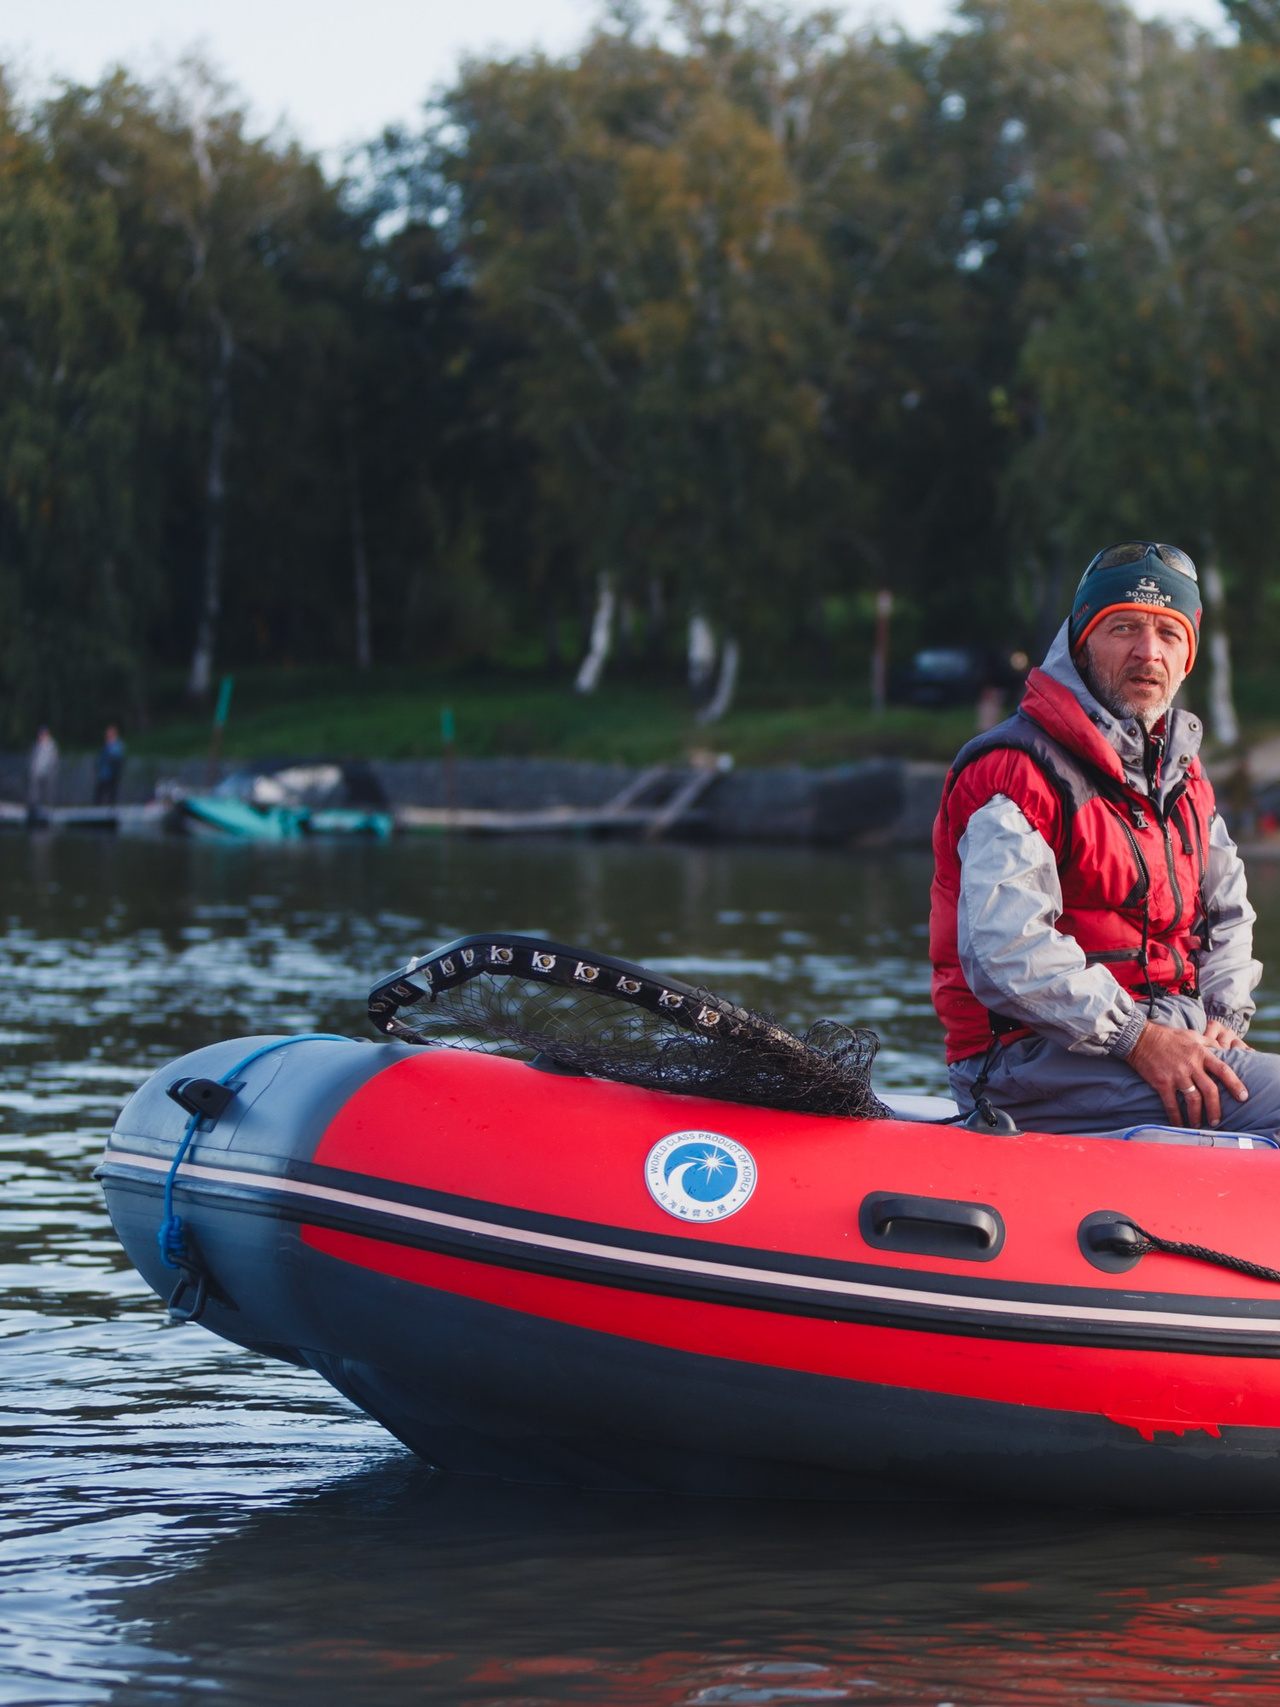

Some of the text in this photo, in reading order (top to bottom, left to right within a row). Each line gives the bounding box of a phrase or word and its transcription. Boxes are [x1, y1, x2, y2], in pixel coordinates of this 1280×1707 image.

[1126, 590, 1172, 603] ЗОЛОТАЯ
[650, 1132, 752, 1193] WORLD CLASS PRODUCT OF KOREA
